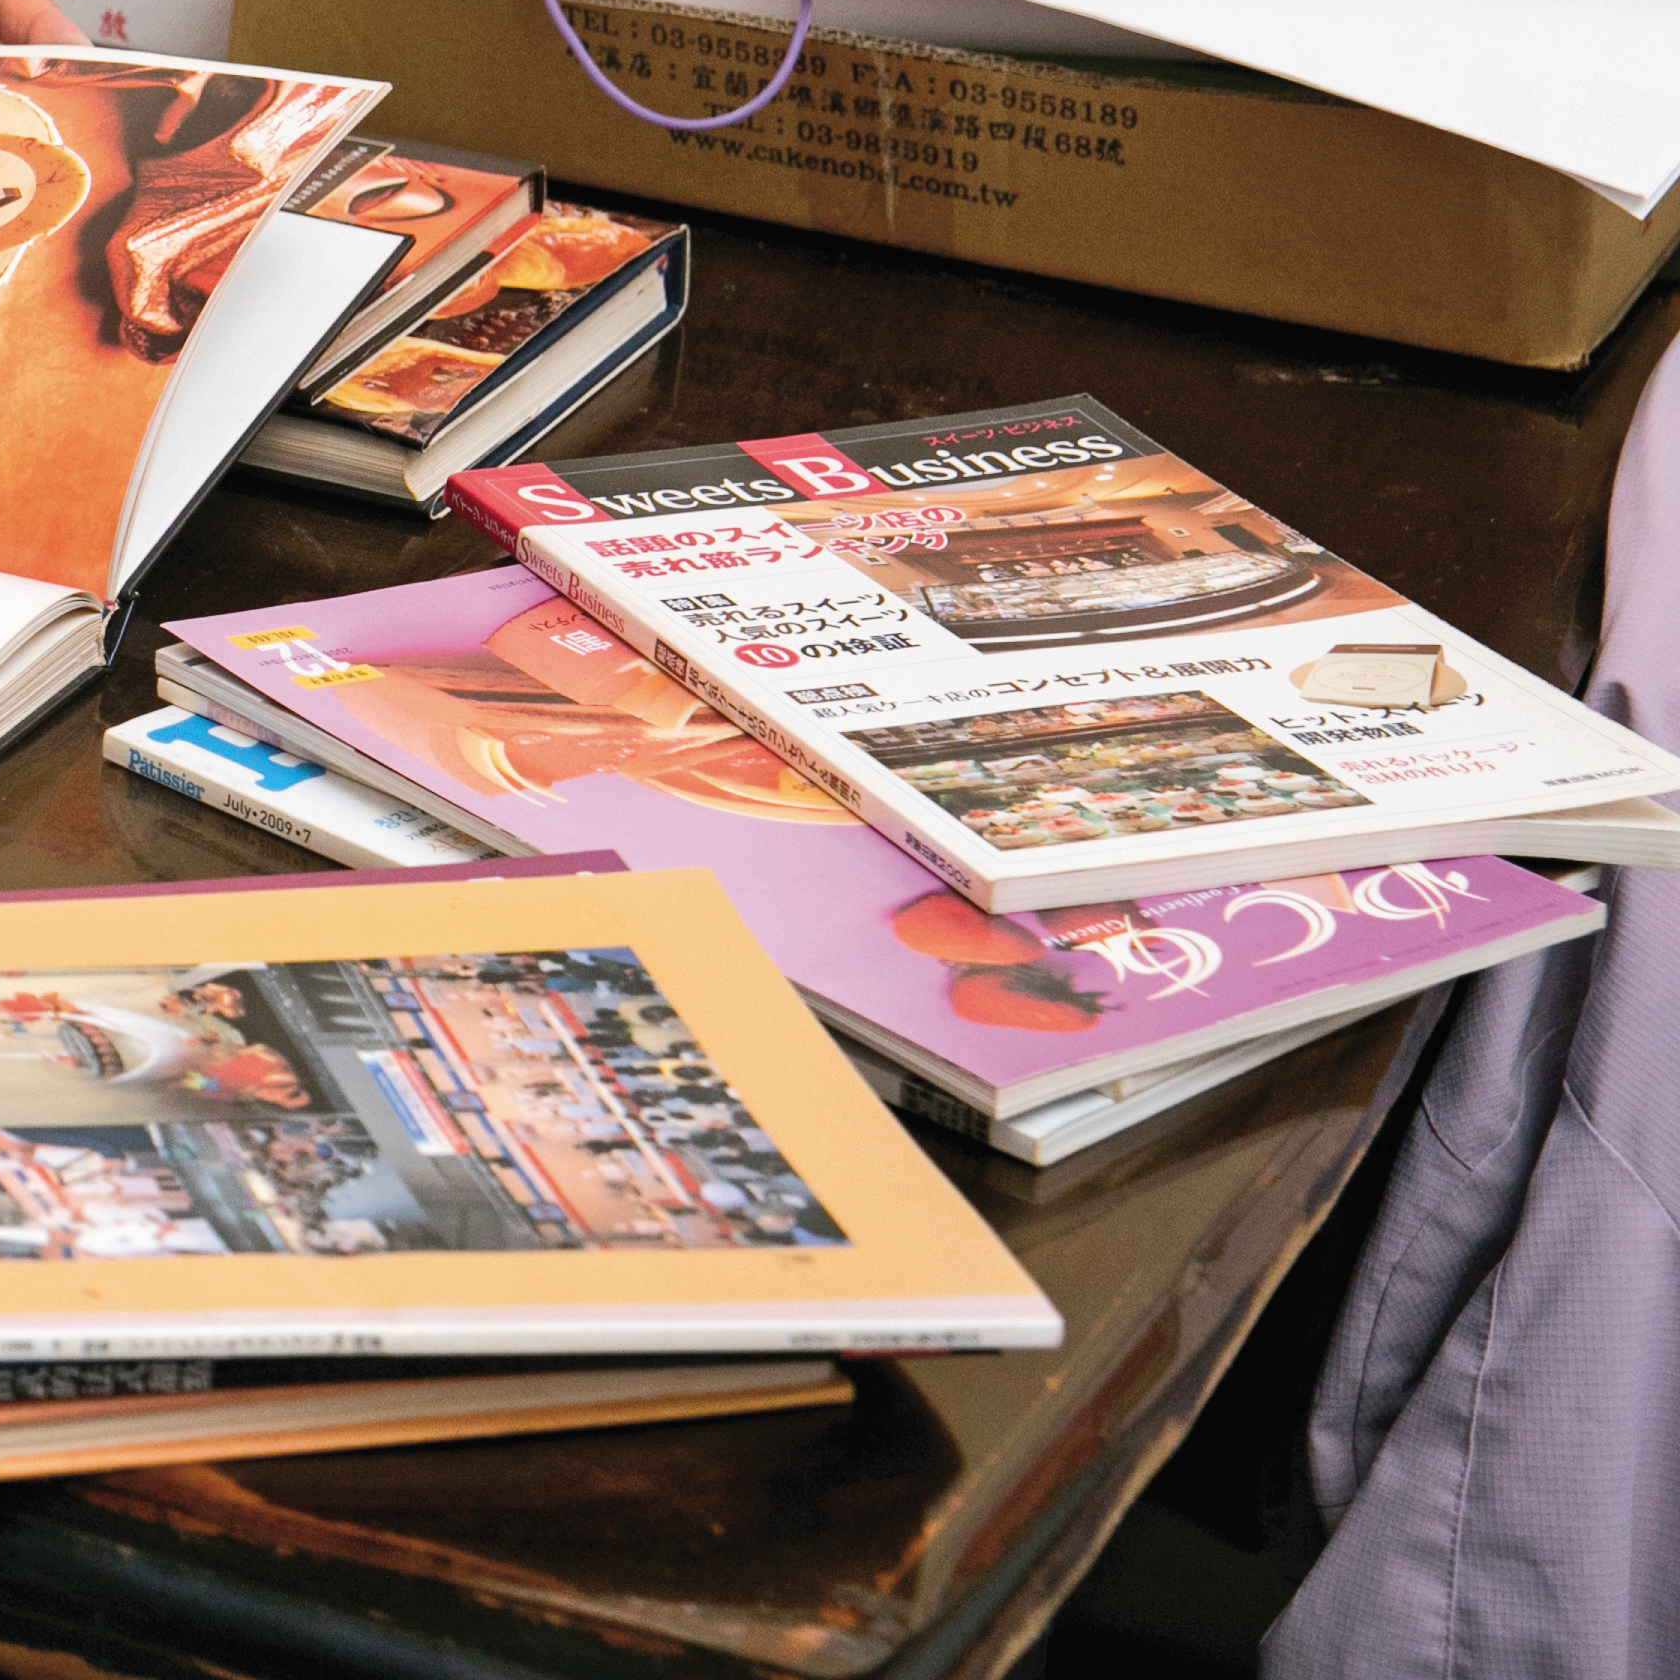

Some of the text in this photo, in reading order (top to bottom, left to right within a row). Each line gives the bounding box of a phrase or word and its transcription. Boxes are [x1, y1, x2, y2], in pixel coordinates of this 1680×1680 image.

[516, 430, 1124, 522] Sweets Business
[584, 504, 966, 559] 話題のスイーツ店の
[610, 527, 952, 580] 売れ筋ランキング
[518, 536, 626, 633] Sweets Business
[527, 613, 587, 633] ンテスト
[684, 591, 888, 627] 売れるスイーツ
[715, 607, 910, 645] 人気のスイーツ
[256, 639, 351, 678] 12
[1290, 721, 1424, 748] 開発物語
[127, 748, 206, 802] Pâtissier
[1039, 918, 1126, 951] Glacerie
